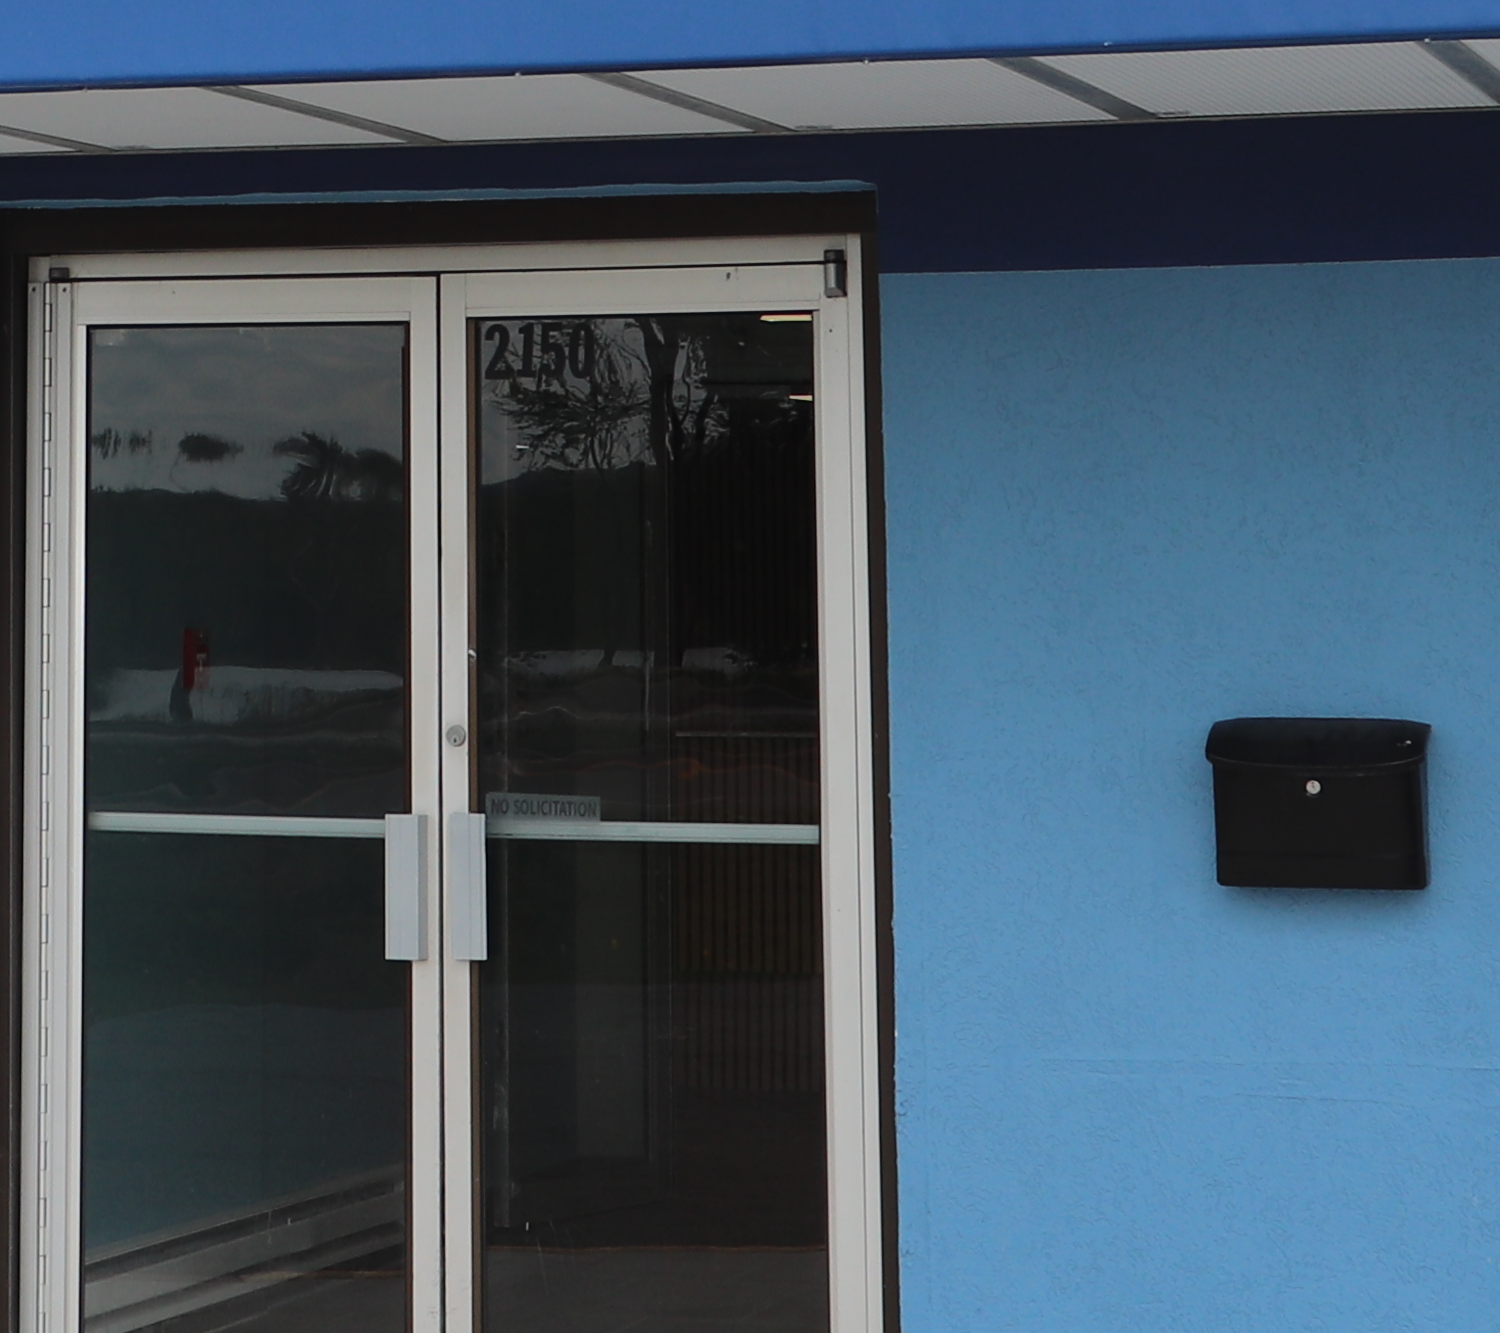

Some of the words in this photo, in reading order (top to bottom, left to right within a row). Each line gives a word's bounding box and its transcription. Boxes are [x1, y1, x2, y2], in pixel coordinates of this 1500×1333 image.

[484, 322, 596, 380] 2150
[491, 798, 509, 814] NO
[513, 799, 596, 817] SOLICITATION
